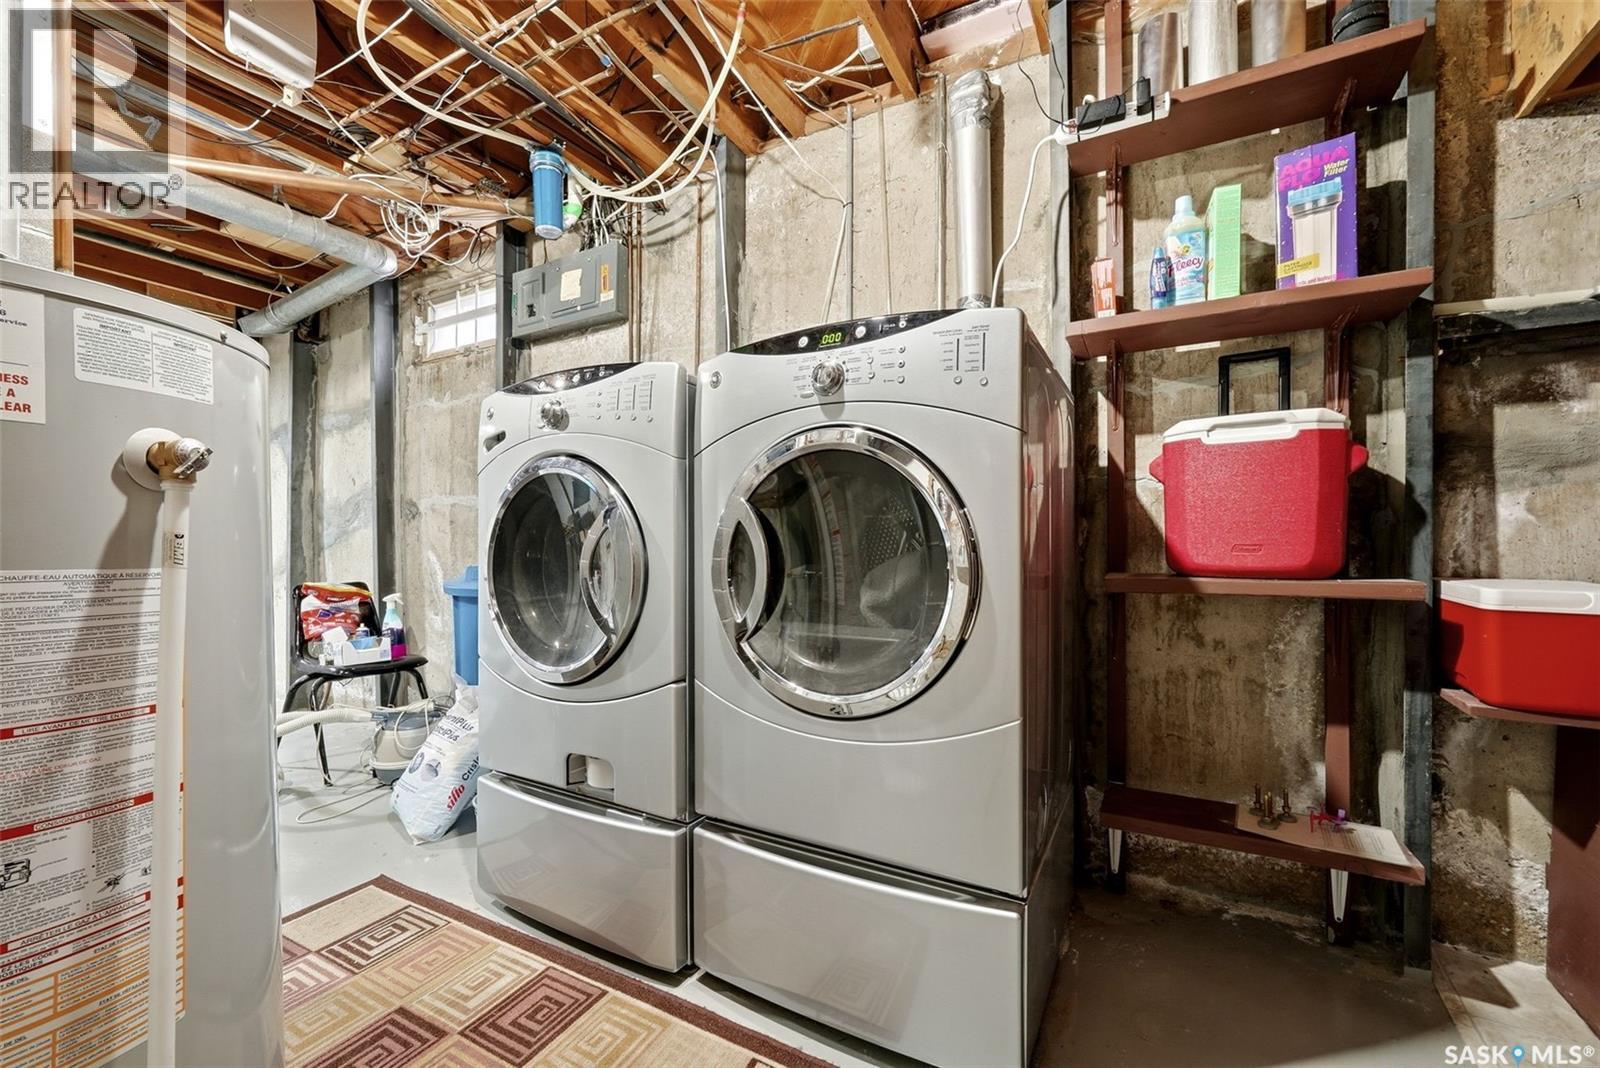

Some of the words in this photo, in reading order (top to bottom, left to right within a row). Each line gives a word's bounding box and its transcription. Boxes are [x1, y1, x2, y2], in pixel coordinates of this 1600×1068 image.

[1280, 145, 1350, 178] AQUA
[1323, 158, 1350, 173] Water
[1323, 165, 1348, 179] Filter
[1167, 257, 1204, 278] Fleecy
[99, 324, 132, 336] IMPORTANT
[6, 388, 16, 398] A
[42, 723, 68, 731] AVANT
[32, 950, 59, 963] CODES
